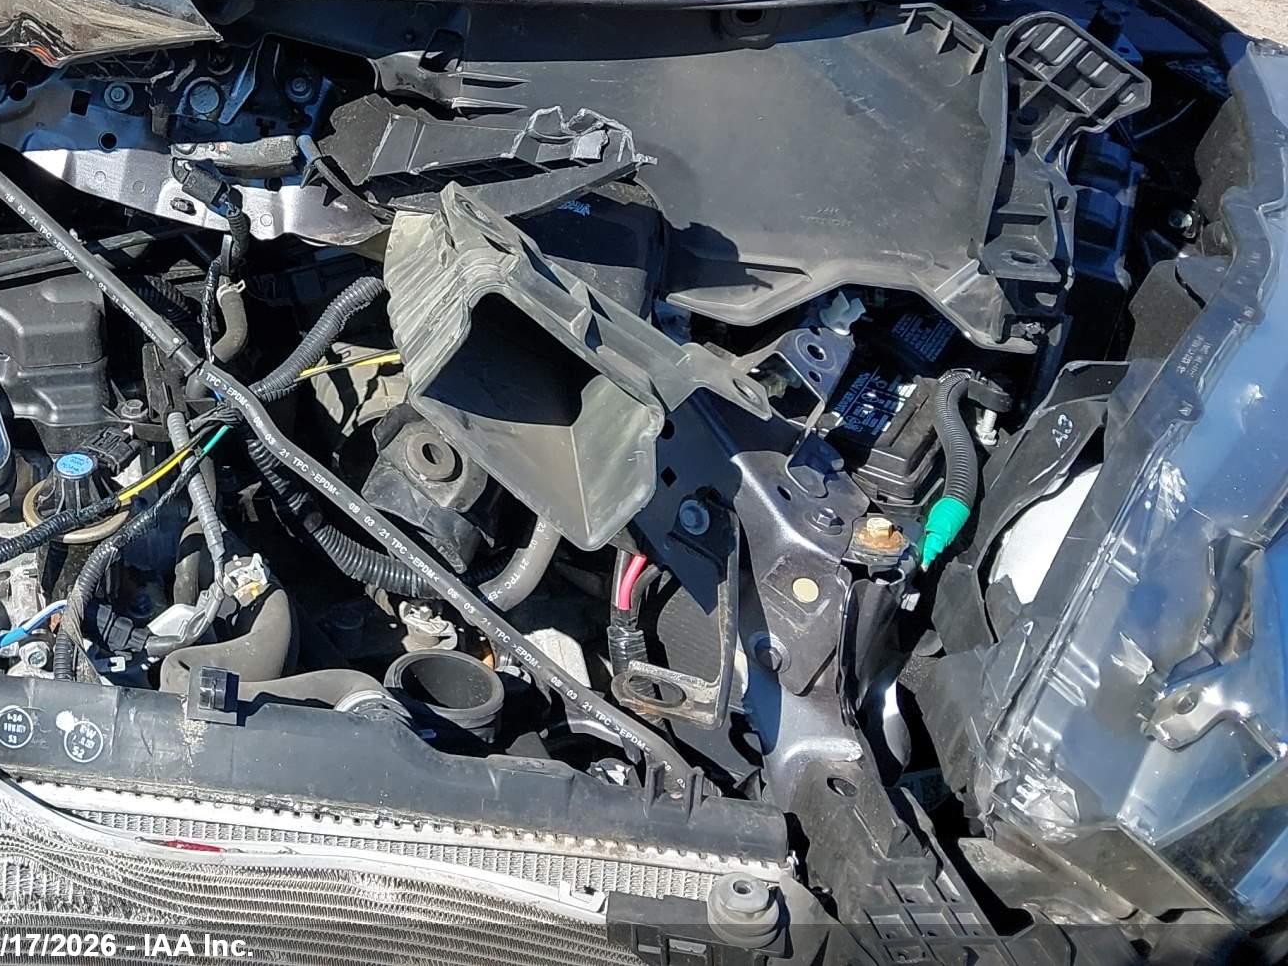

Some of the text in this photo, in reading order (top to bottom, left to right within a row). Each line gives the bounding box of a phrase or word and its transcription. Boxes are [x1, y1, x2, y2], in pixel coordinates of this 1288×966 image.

[29, 216, 39, 226] 21
[39, 224, 52, 239] TPC
[536, 521, 547, 533] 23
[205, 372, 221, 387] TPC
[223, 384, 251, 410] >EPDM<
[278, 448, 291, 459] 21
[292, 456, 309, 472] TPC
[311, 470, 340, 495] >EPDM<
[363, 516, 376, 527] 03
[378, 528, 391, 539] 21
[391, 537, 408, 555] TPC
[408, 553, 440, 582] >EPDM<
[463, 602, 475, 613] 03
[480, 617, 492, 627] 21
[494, 627, 511, 643] TPC
[512, 643, 542, 669] >EPDM<
[566, 689, 578, 700] 03
[582, 701, 594, 713] 21
[595, 710, 612, 726] TPC
[613, 723, 652, 752] >EPDM<
[519, 557, 530, 571] 21
[504, 572, 521, 589] TPC
